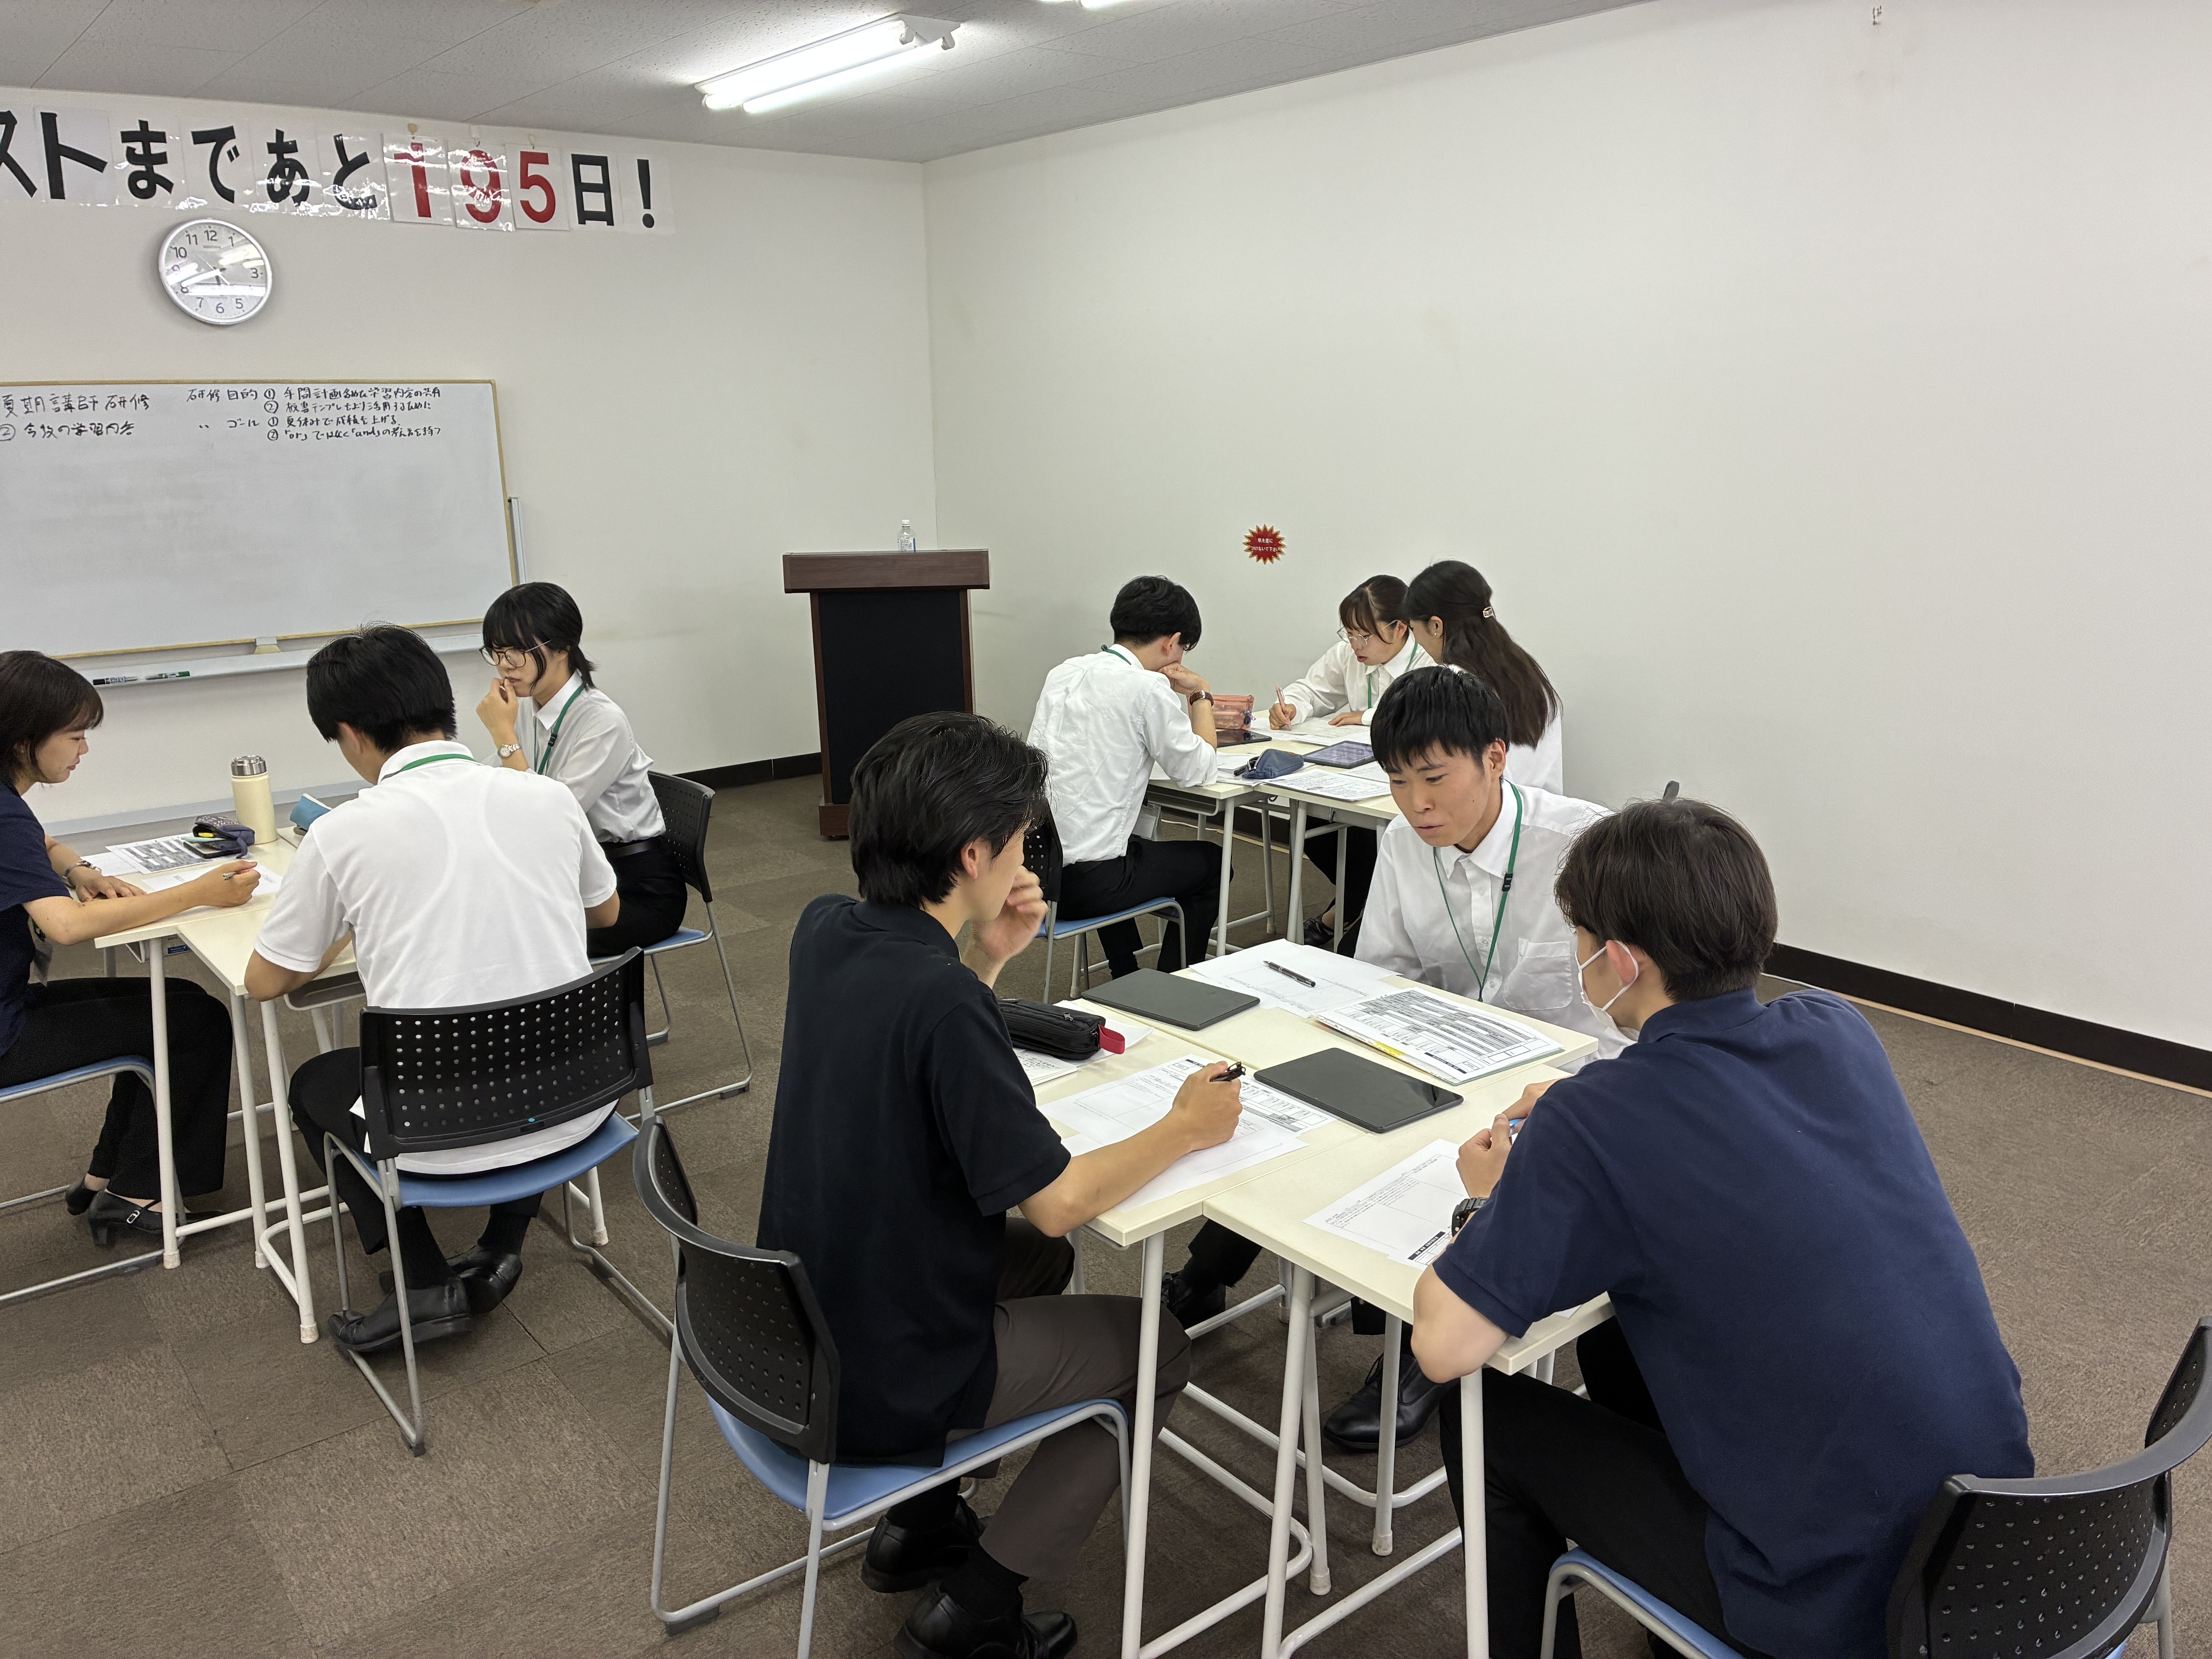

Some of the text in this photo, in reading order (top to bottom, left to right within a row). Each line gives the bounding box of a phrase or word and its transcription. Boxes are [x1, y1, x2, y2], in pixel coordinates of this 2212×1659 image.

[186, 234, 198, 245] 11
[204, 230, 218, 241] 12
[228, 236, 234, 247] 1
[174, 247, 187, 258] 10
[251, 268, 258, 278] 3
[196, 297, 203, 308] 7
[216, 303, 224, 313] 6
[235, 299, 243, 309] 5
[227, 418, 260, 428] ゴール
